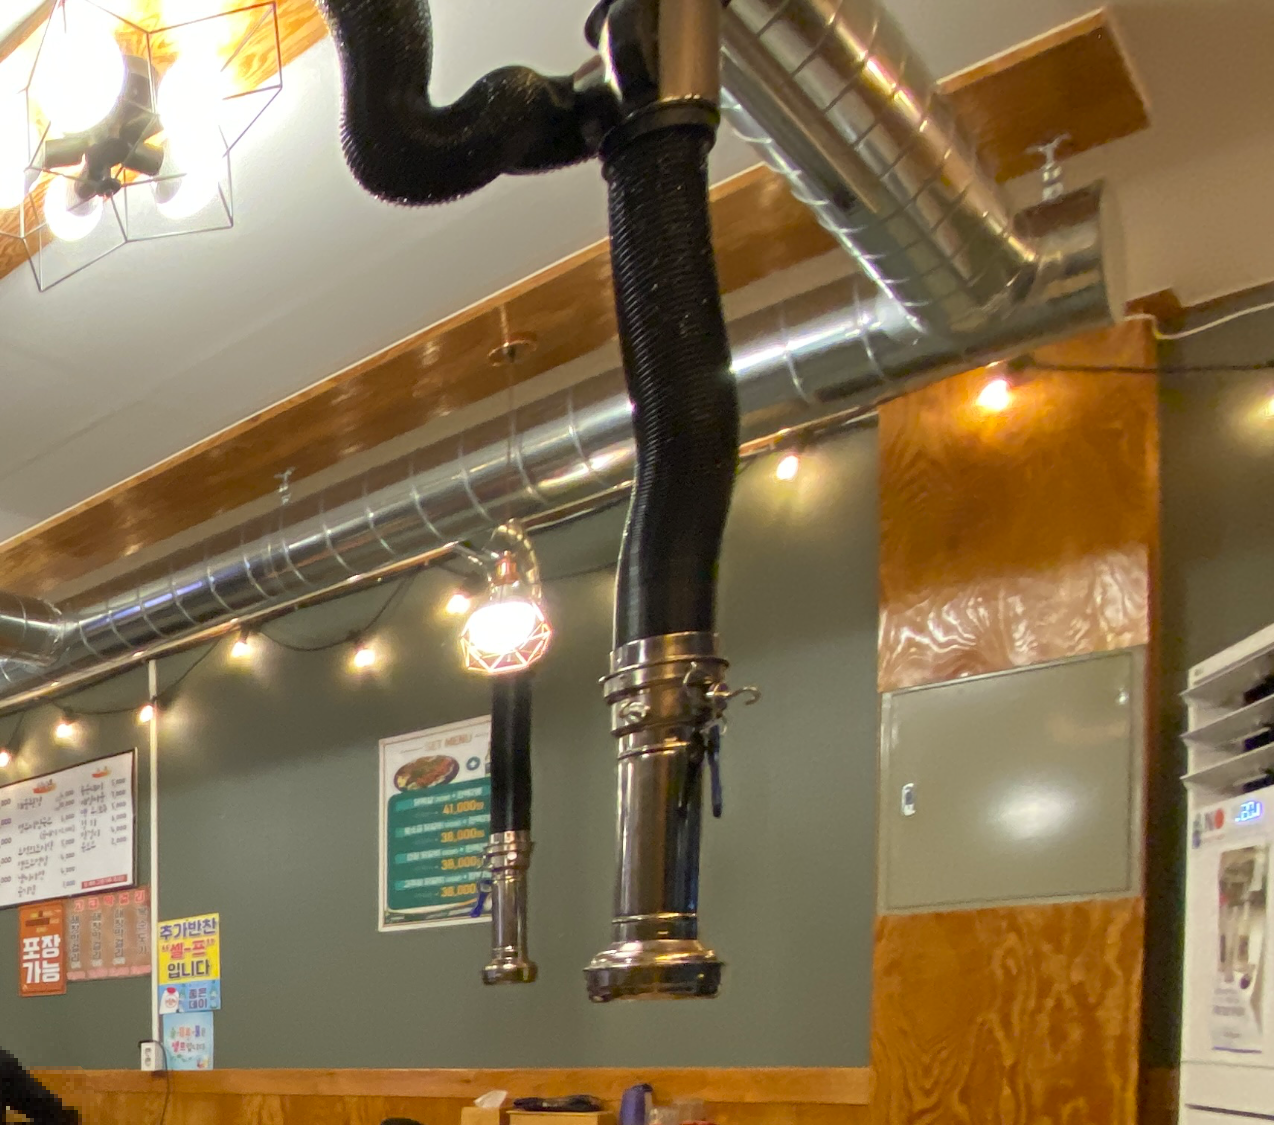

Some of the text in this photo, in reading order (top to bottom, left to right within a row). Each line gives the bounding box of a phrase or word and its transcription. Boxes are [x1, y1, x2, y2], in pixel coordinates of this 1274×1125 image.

[160, 917, 217, 941] 추가반찬
[23, 934, 61, 960] 포장
[23, 960, 61, 984] 가능
[167, 959, 211, 980] 입니다
